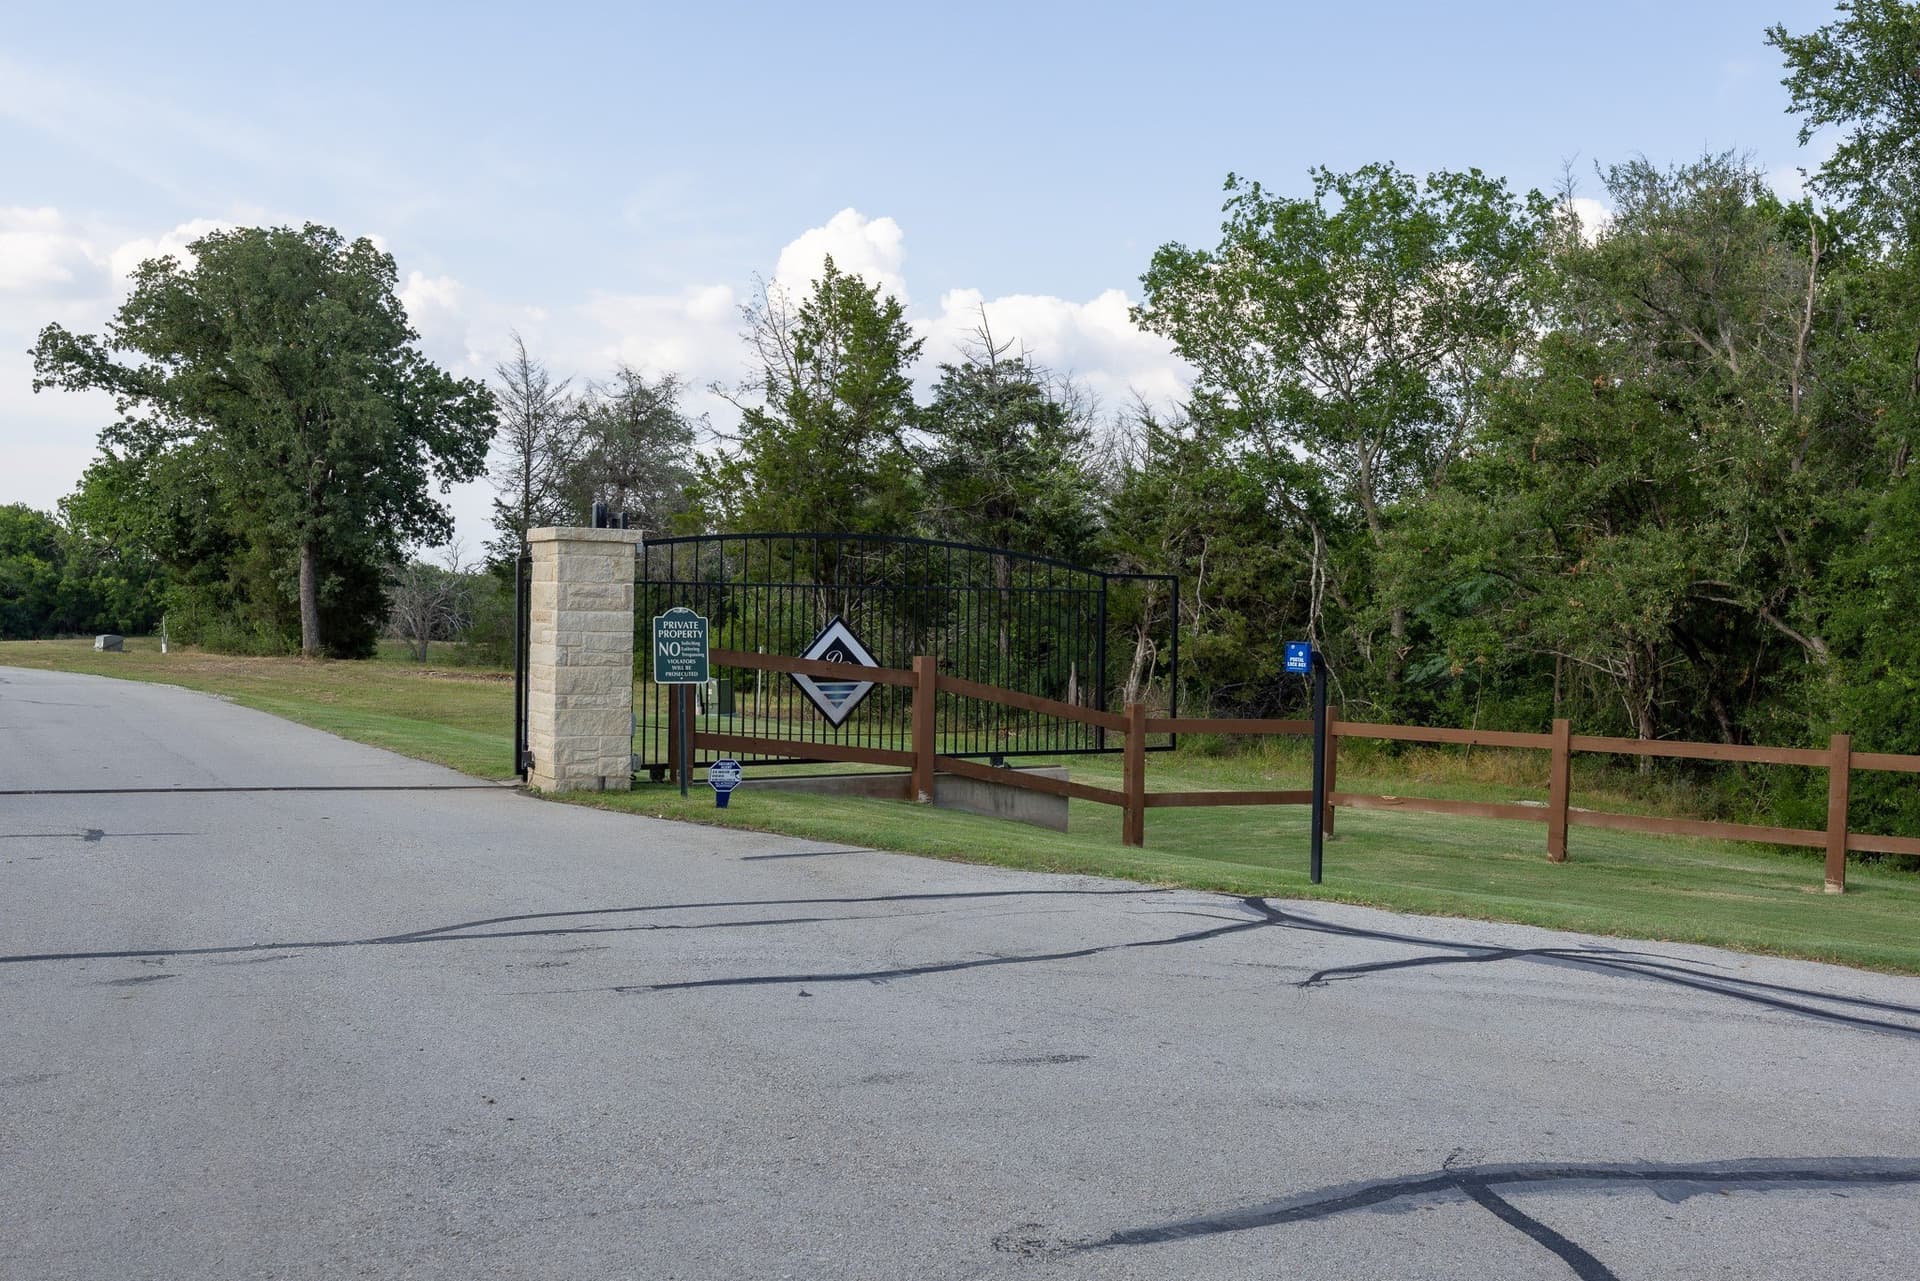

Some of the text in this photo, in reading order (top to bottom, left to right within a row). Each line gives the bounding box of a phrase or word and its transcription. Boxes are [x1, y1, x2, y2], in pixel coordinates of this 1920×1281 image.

[663, 621, 699, 629] PRIVATE
[658, 630, 704, 638] PROPERTY
[658, 641, 681, 657] NO
